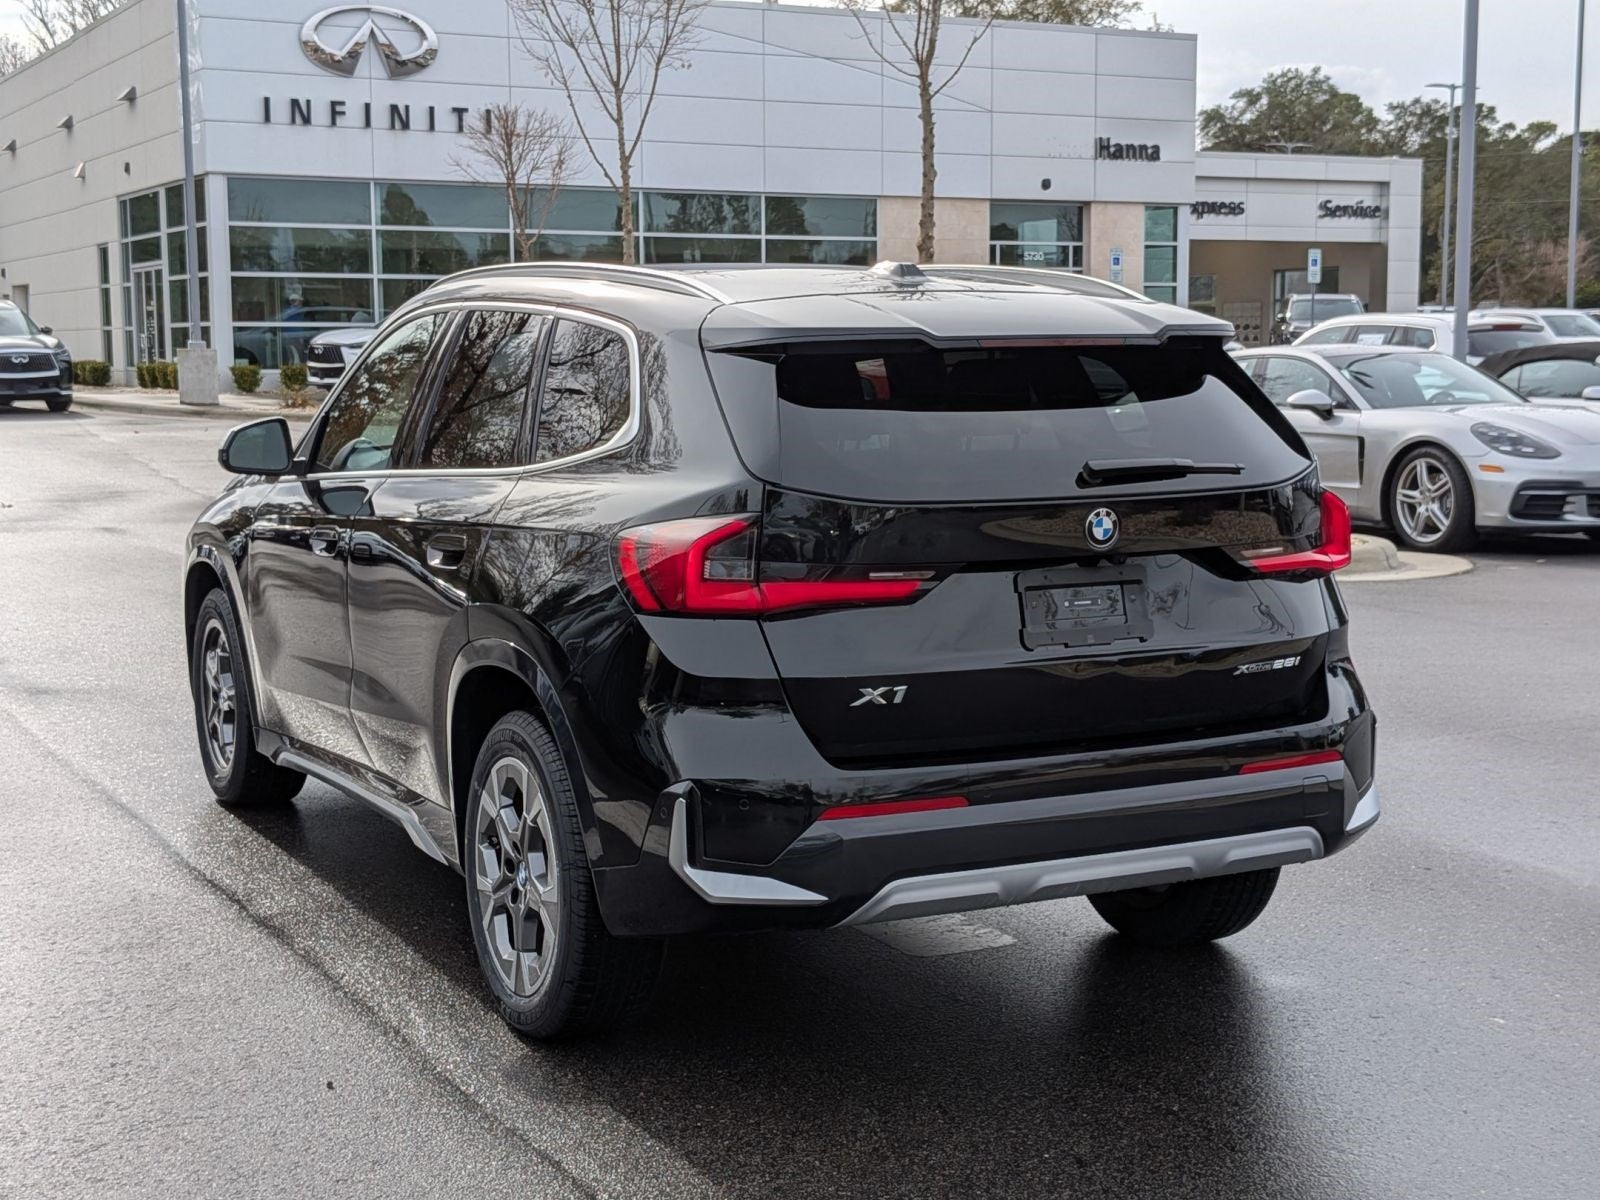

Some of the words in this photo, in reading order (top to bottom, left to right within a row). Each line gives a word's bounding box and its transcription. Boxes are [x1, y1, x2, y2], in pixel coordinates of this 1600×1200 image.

[263, 96, 492, 134] INFINITI
[1095, 136, 1161, 162] Hanna
[1318, 199, 1382, 219] Service
[849, 685, 908, 707] X1
